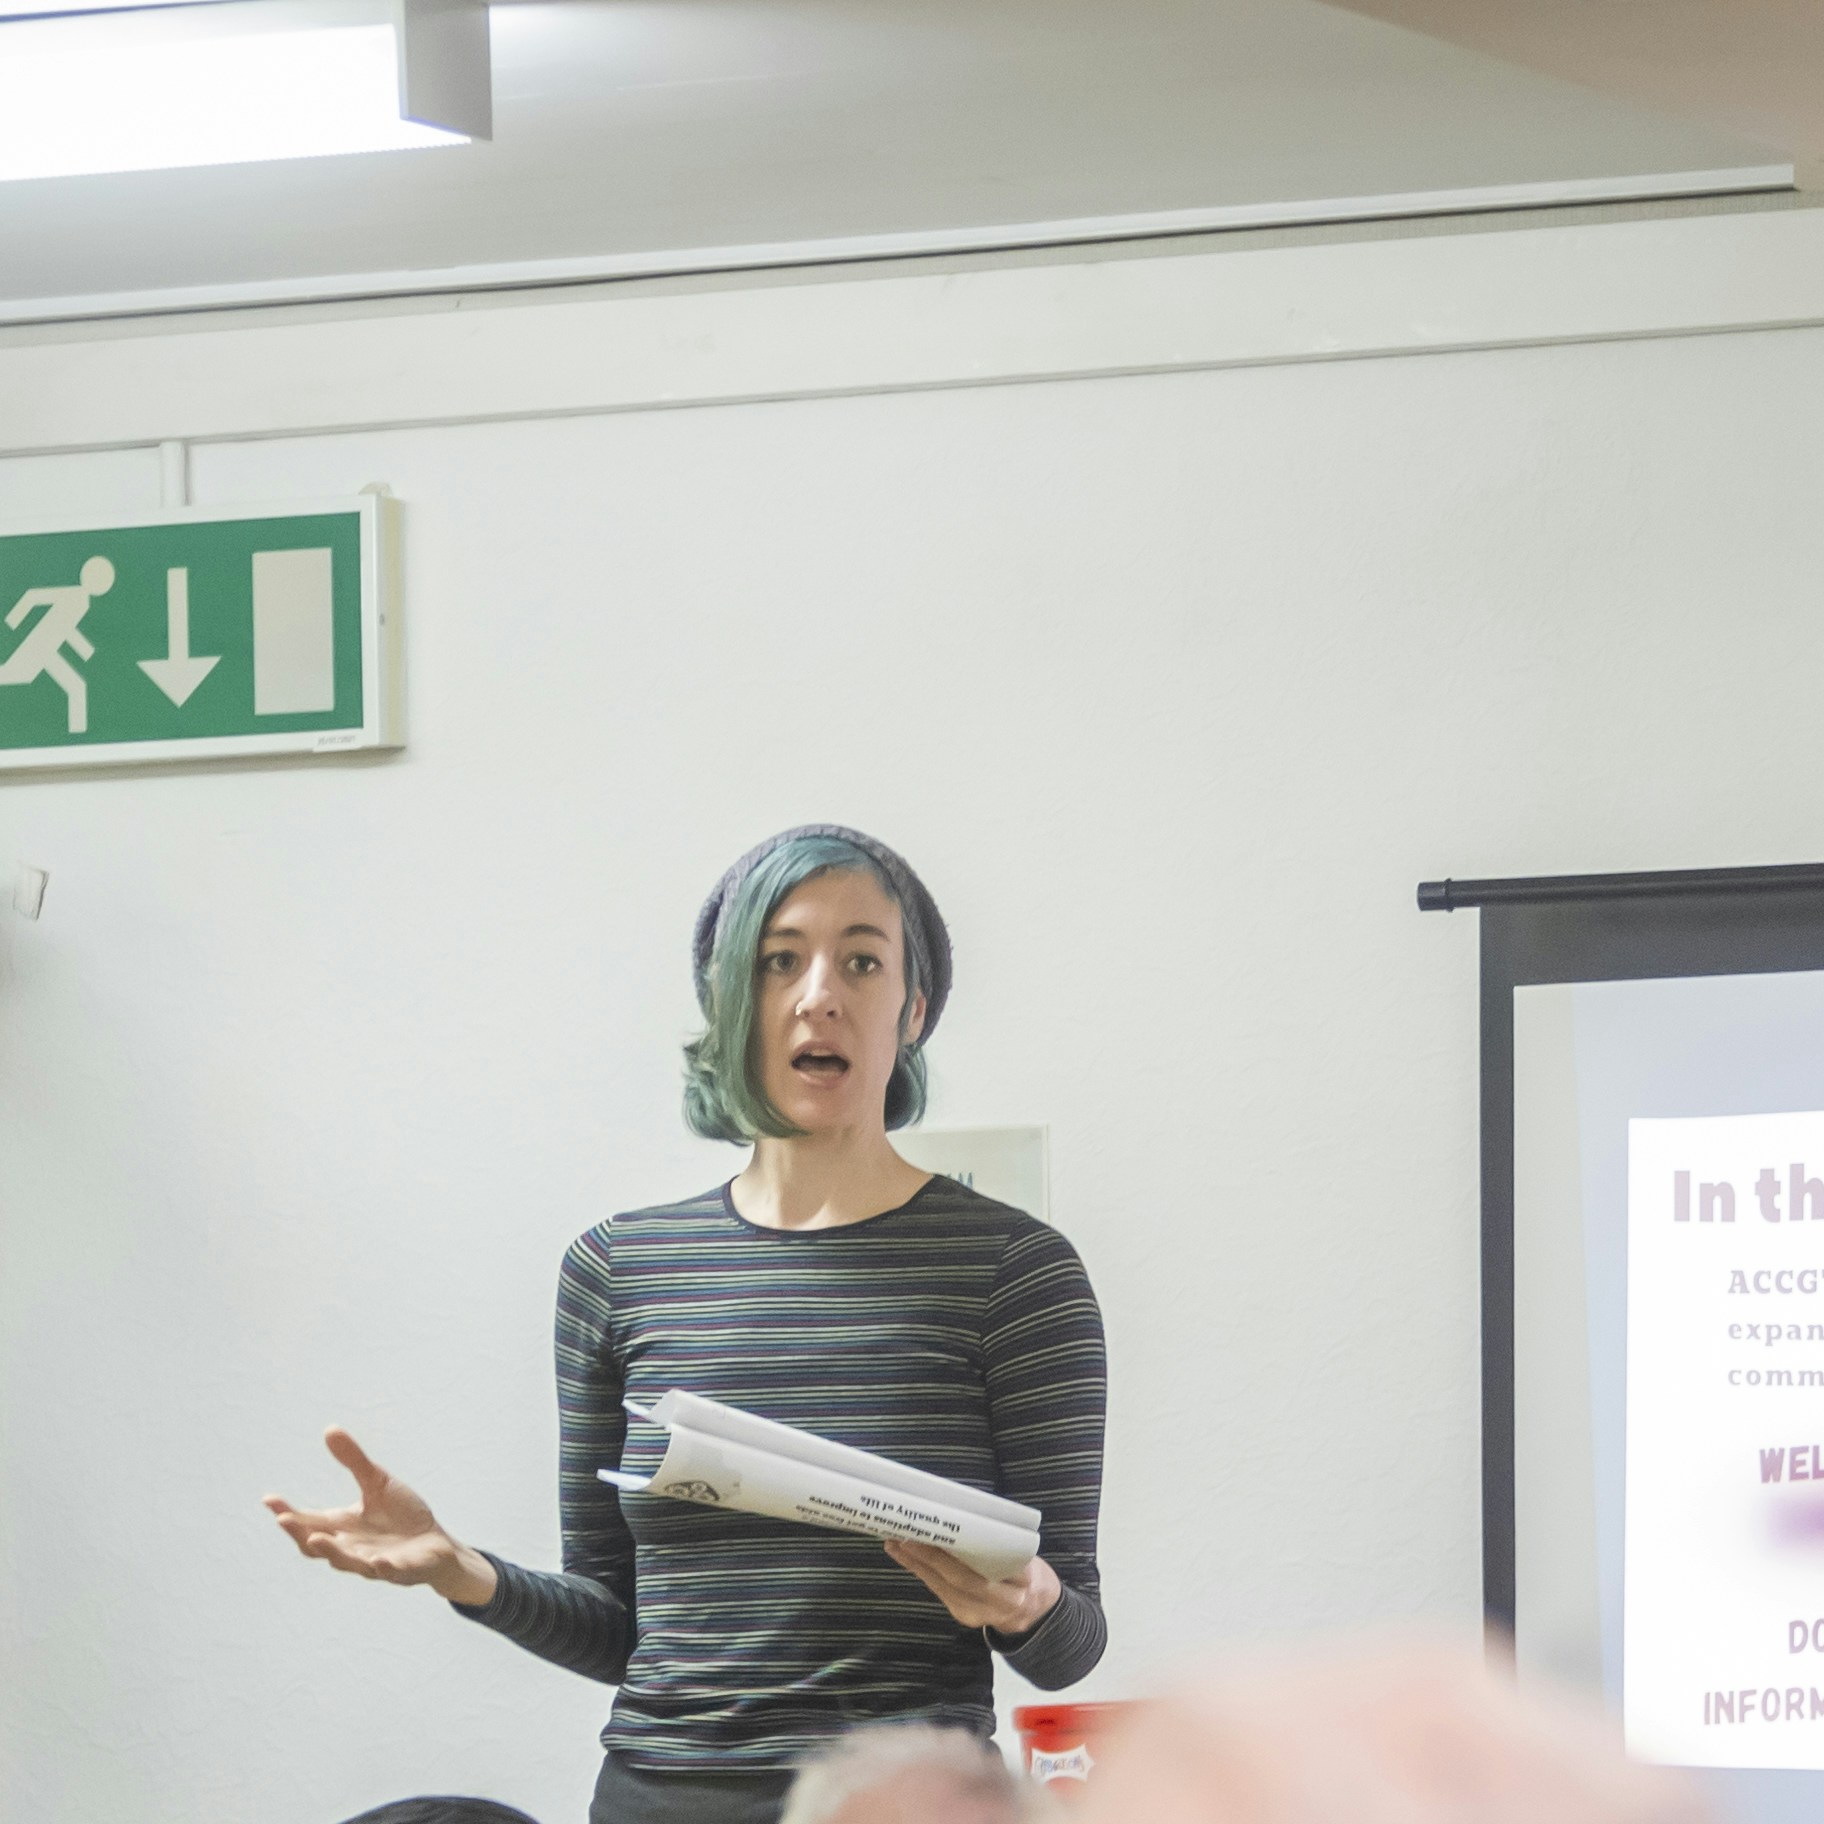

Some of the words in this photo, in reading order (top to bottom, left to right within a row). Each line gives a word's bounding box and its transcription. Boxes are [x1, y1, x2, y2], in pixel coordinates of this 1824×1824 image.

[1673, 1170, 1736, 1223] In
[882, 1502, 895, 1513] of
[859, 1511, 871, 1521] to
[896, 1504, 941, 1526] quality
[942, 1519, 961, 1533] the
[931, 1533, 957, 1546] and
